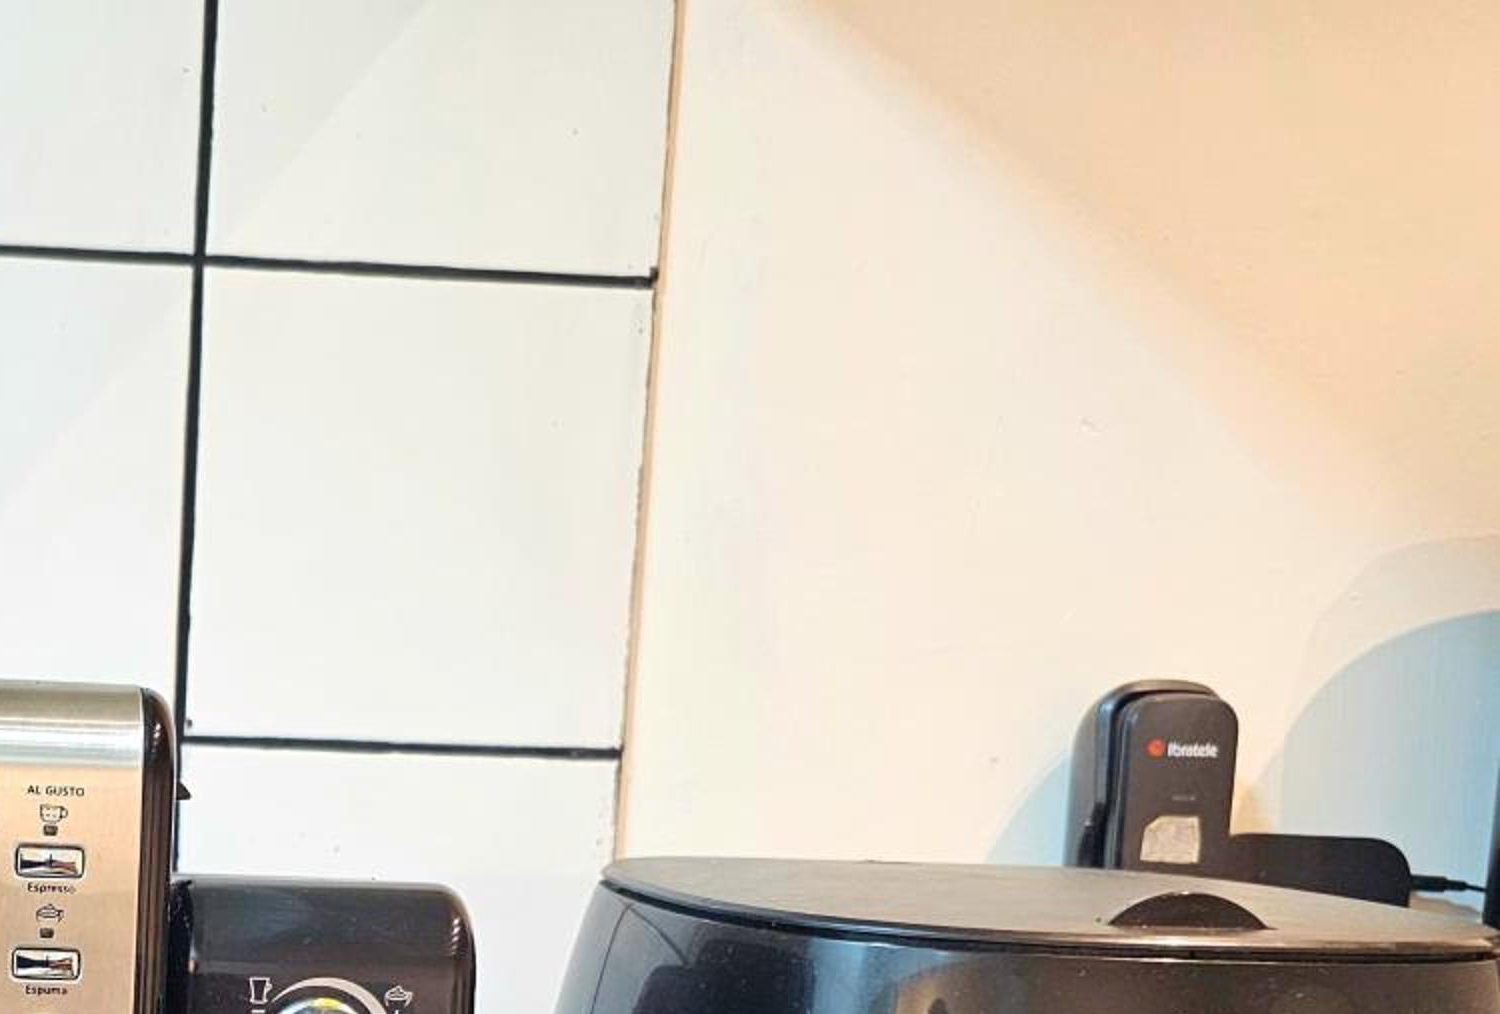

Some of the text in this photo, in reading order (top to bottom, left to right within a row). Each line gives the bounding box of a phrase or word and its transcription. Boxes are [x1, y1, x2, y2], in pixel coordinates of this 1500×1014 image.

[27, 785, 85, 797] AL GUSTO
[27, 882, 76, 895] Espresso
[25, 985, 68, 996] Espuma
